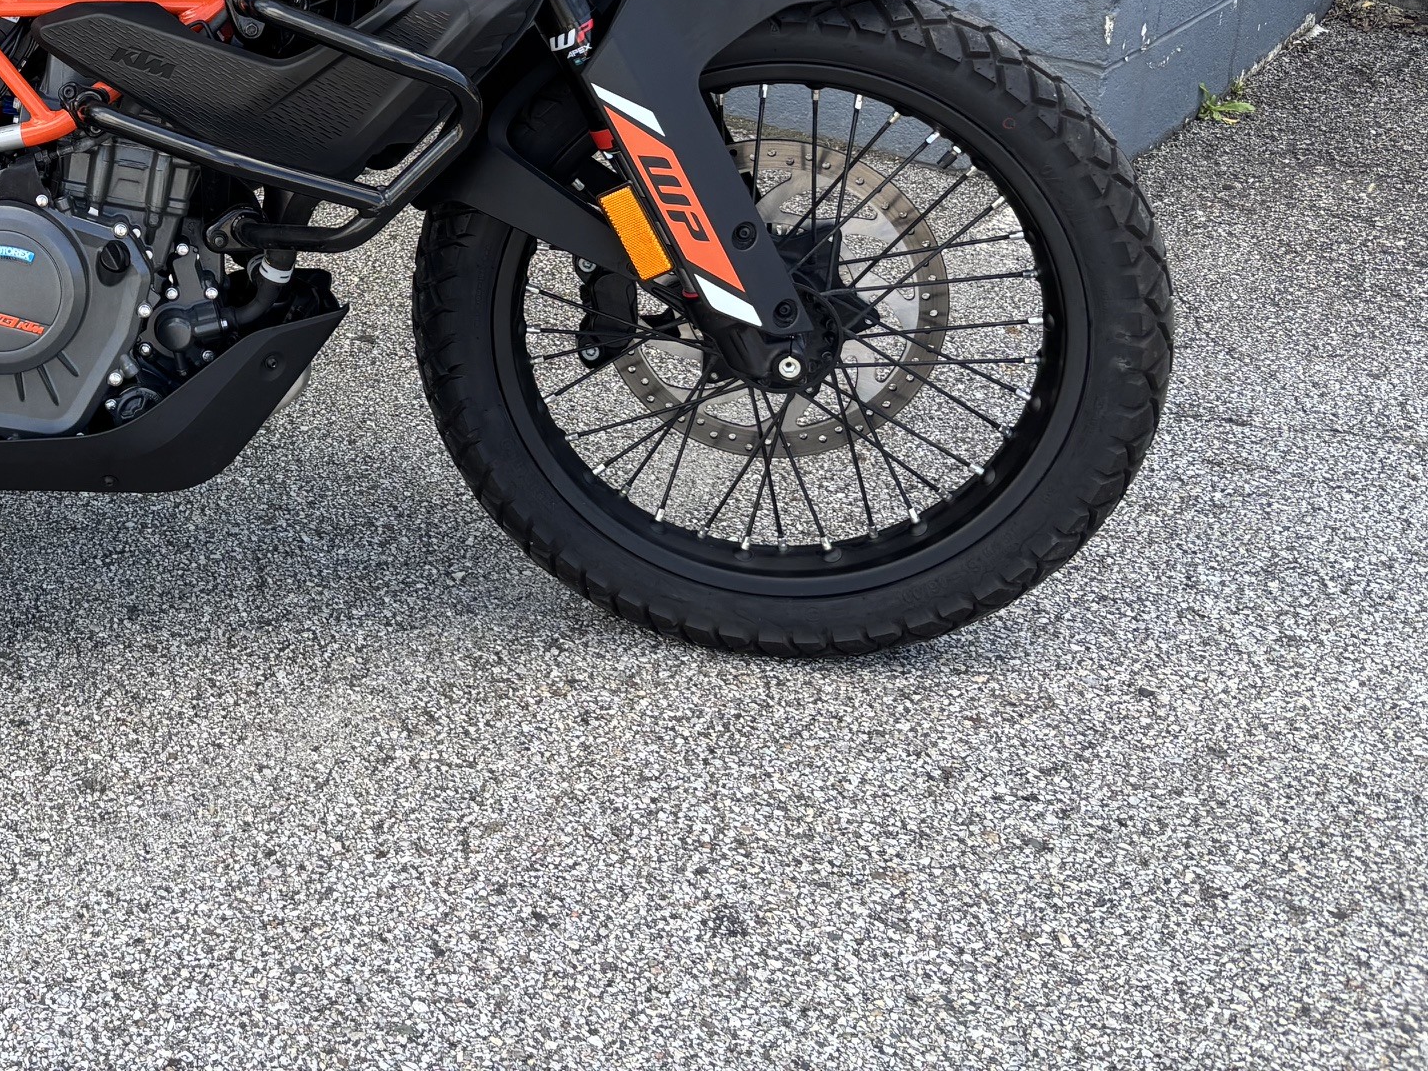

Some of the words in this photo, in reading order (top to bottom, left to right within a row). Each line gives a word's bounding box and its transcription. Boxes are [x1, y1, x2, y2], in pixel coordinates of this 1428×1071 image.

[549, 18, 594, 52] WP
[567, 42, 593, 59] APEX
[110, 47, 176, 80] KTM
[637, 155, 710, 242] WP
[16, 320, 45, 335] KTM
